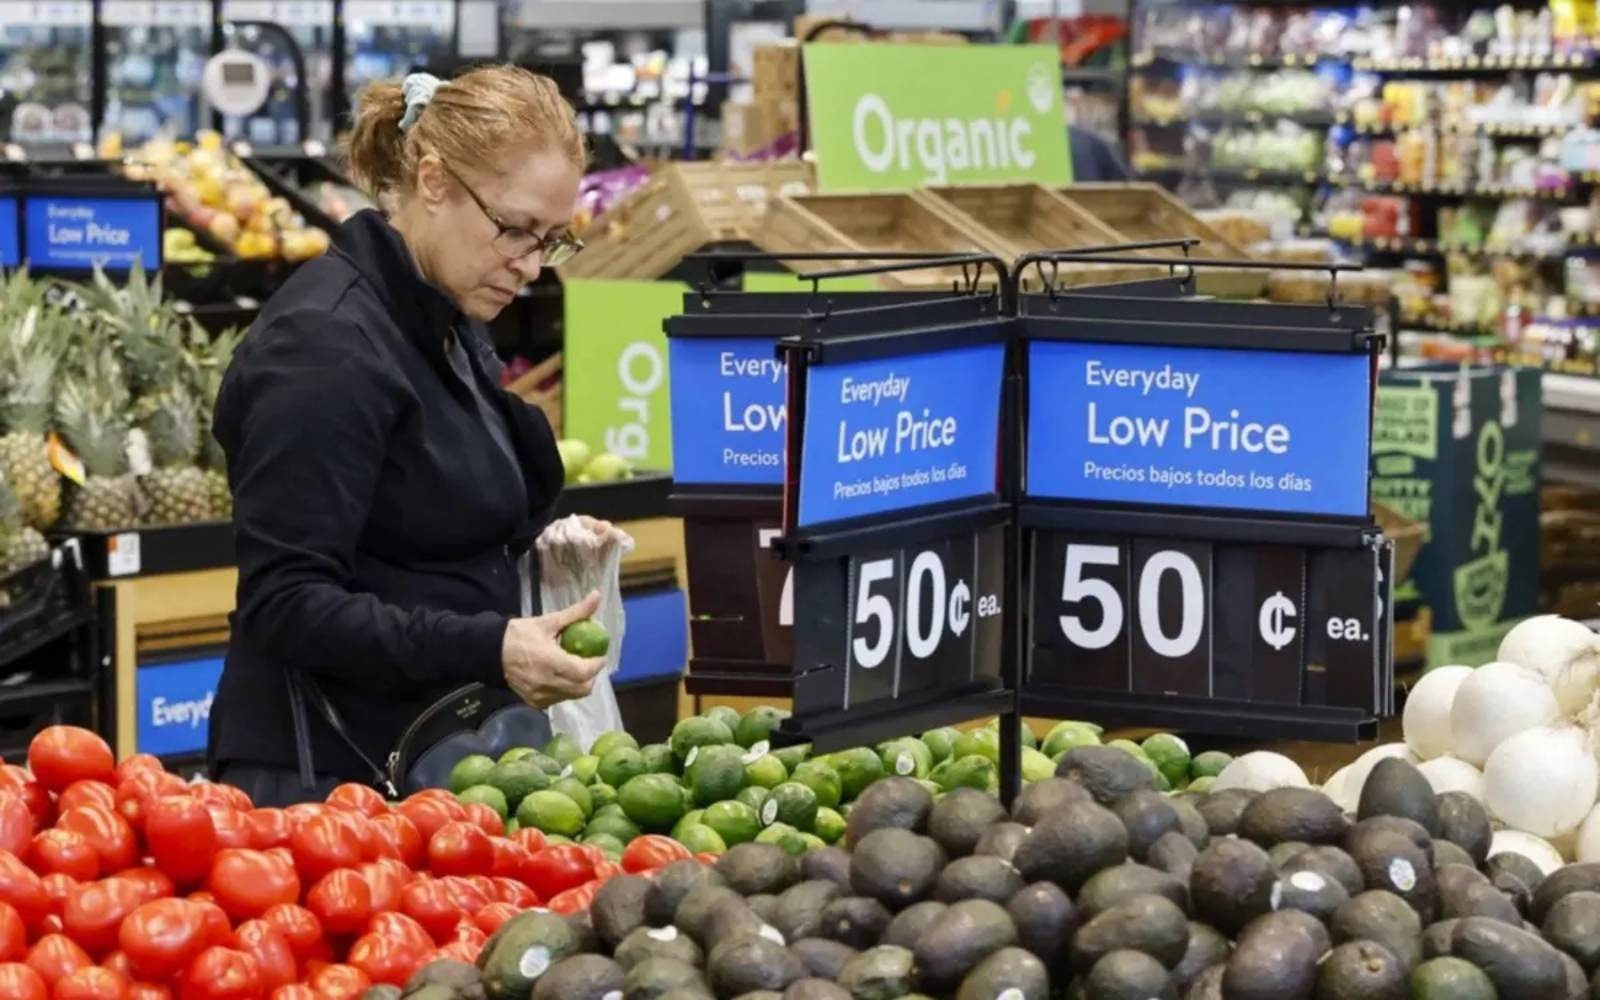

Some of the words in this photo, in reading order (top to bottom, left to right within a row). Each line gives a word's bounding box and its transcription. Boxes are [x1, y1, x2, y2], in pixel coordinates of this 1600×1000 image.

[853, 89, 1036, 185] Organic
[49, 223, 83, 244] Low
[86, 221, 130, 245] Price
[721, 351, 788, 384] Every
[1085, 360, 1200, 398] Everyday
[841, 372, 910, 406] Everyday
[837, 420, 889, 463] Low
[895, 409, 957, 454] Price
[1087, 402, 1169, 447] Low
[1184, 406, 1290, 454] Price
[723, 447, 779, 466] Precios
[833, 480, 871, 499] Precios
[873, 475, 900, 496] bajos
[902, 470, 930, 488] todos
[932, 467, 946, 482] los
[1084, 461, 1145, 482] Precios
[1149, 465, 1192, 489] bajos
[1197, 469, 1245, 488] todos
[1250, 471, 1274, 489] los
[1278, 472, 1312, 492] días
[977, 593, 1001, 618] ea.
[1058, 543, 1205, 658] 50
[1258, 590, 1298, 651] ¢
[1325, 616, 1370, 641] ea.
